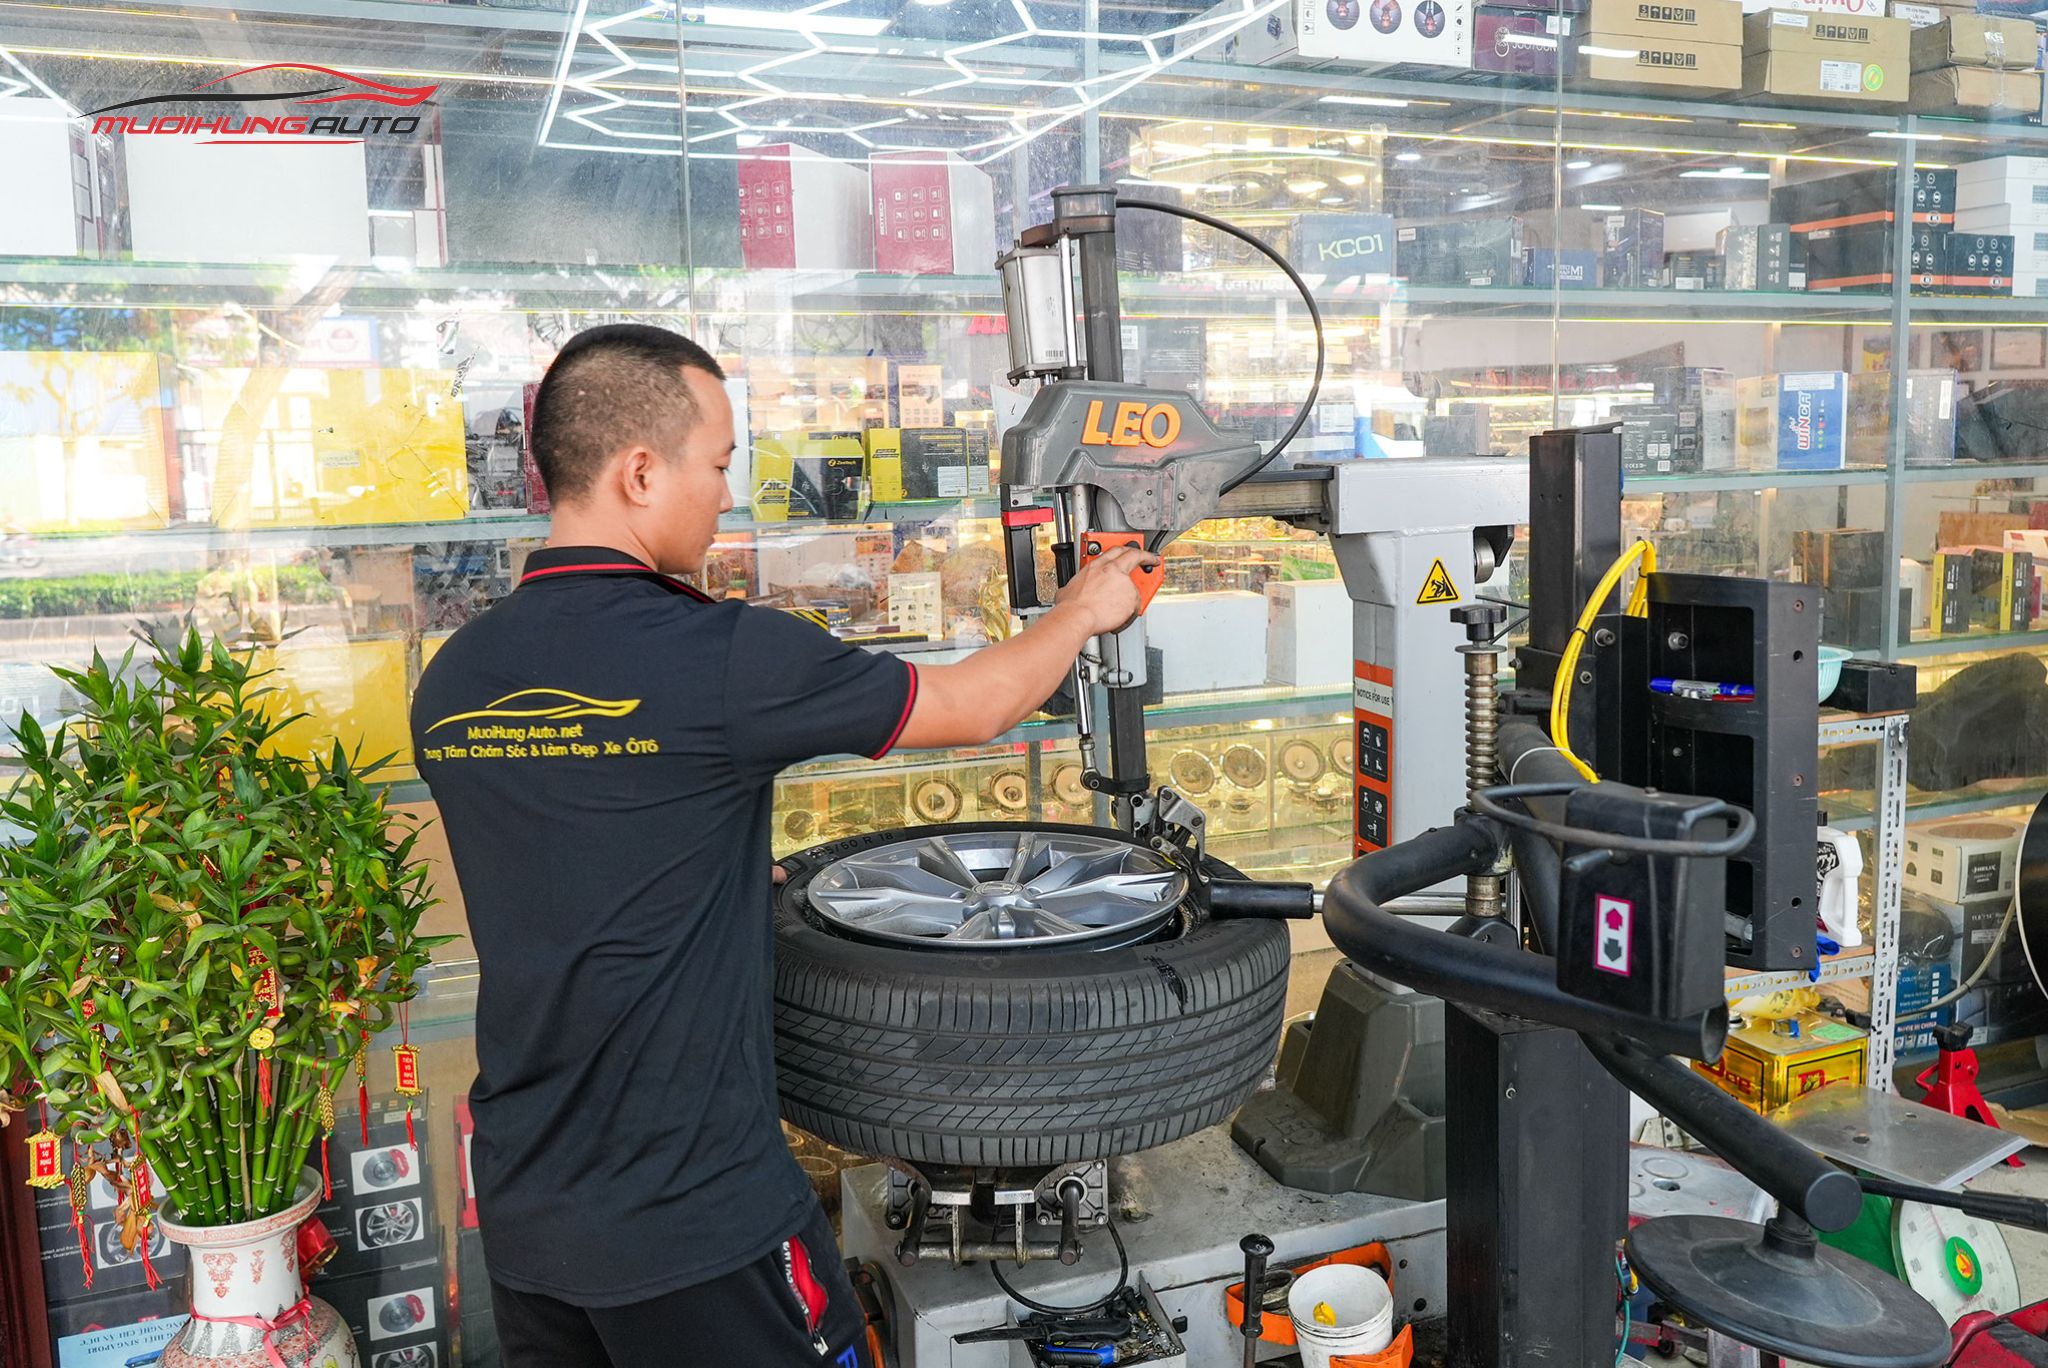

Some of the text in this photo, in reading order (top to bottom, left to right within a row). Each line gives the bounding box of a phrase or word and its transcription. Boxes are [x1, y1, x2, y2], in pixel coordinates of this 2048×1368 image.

[1081, 400, 1181, 448] LEO
[1356, 688, 1390, 706] NOTICE FOR USE
[467, 725, 526, 742] MuoiHung
[530, 744, 540, 757] &
[603, 740, 622, 755] Xe
[862, 836, 873, 844] R
[878, 832, 894, 841] 18
